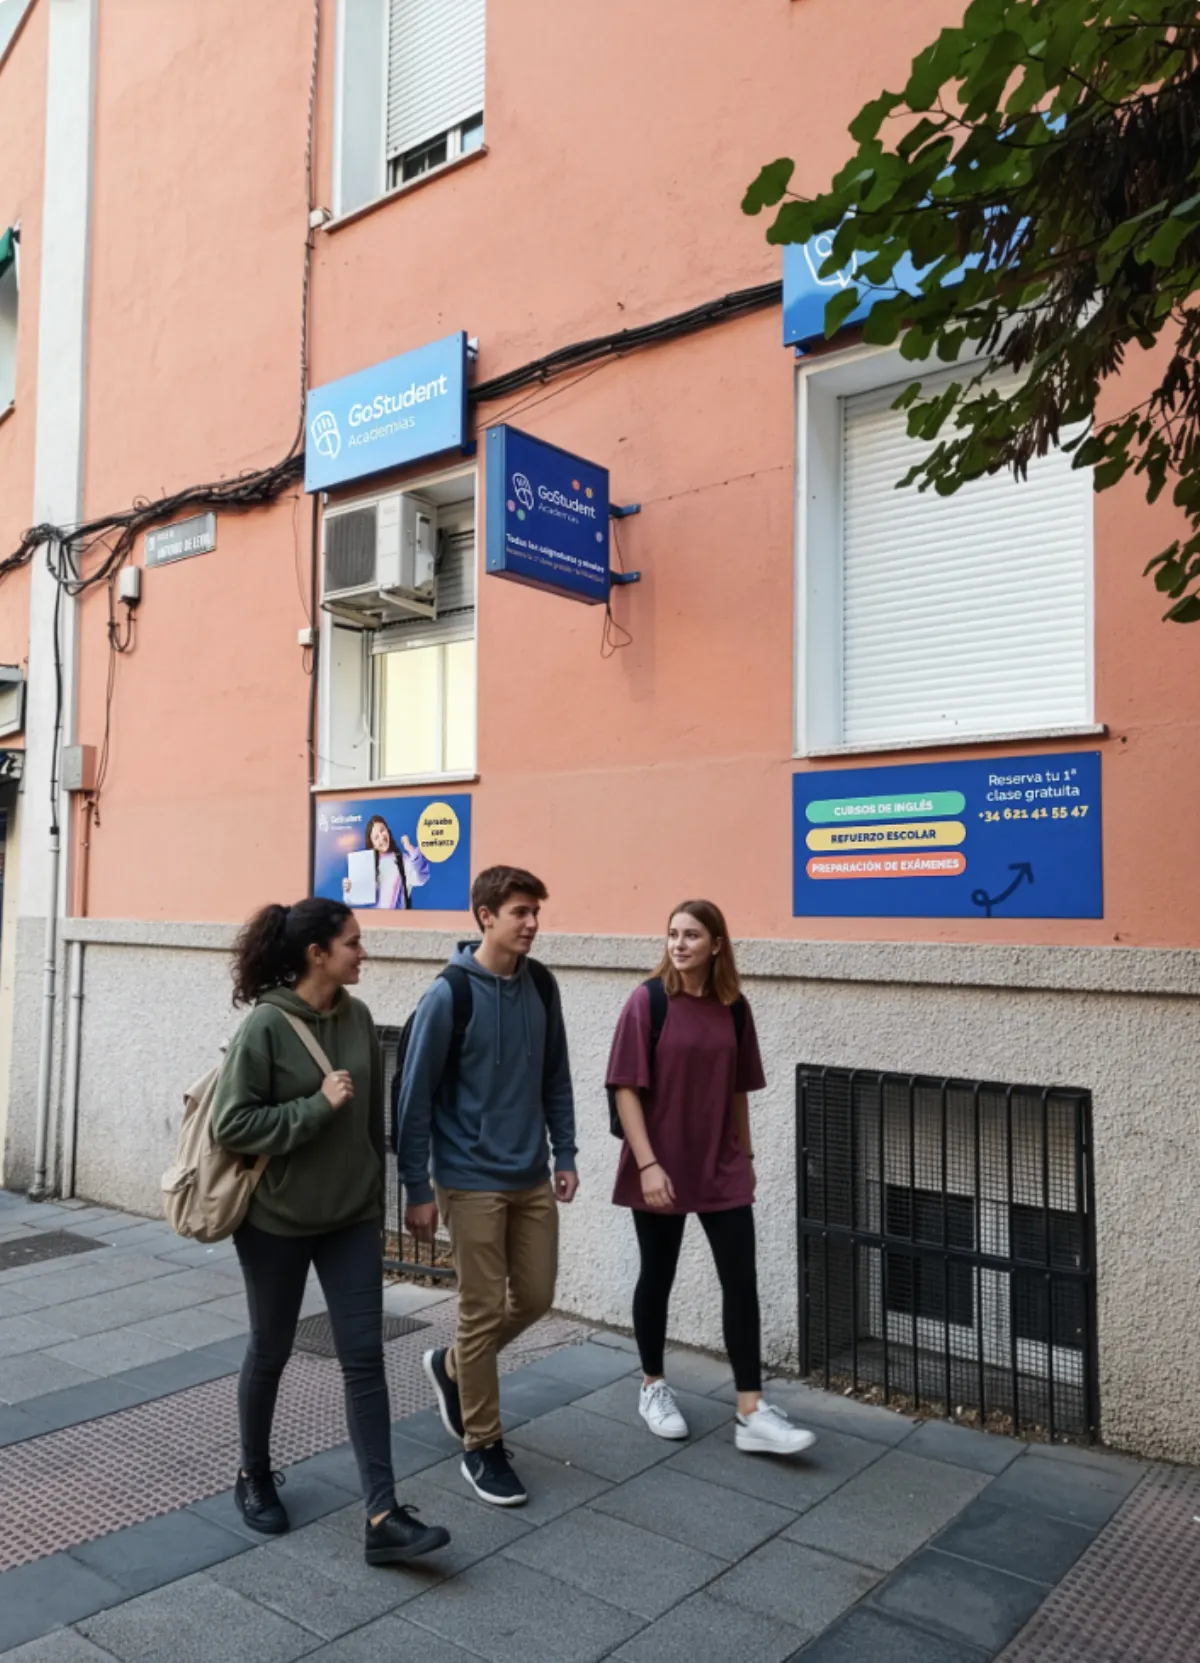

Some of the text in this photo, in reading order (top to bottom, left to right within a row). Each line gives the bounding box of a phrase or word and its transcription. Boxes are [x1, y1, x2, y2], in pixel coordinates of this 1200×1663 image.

[348, 373, 448, 427] GoStudent
[348, 416, 416, 448] Academias
[538, 485, 596, 519] GoStudent
[988, 773, 1043, 786] Reserva
[1045, 770, 1060, 782] tu
[986, 785, 1081, 803] clase gratuita
[834, 799, 933, 816] CURSOS DE INGLÉS
[979, 805, 1089, 822] +34 621 41 55 47
[831, 829, 936, 844] REFUERZO ESCOLAR
[812, 858, 960, 873] PREPARACIÓN DE EXÁMENES
